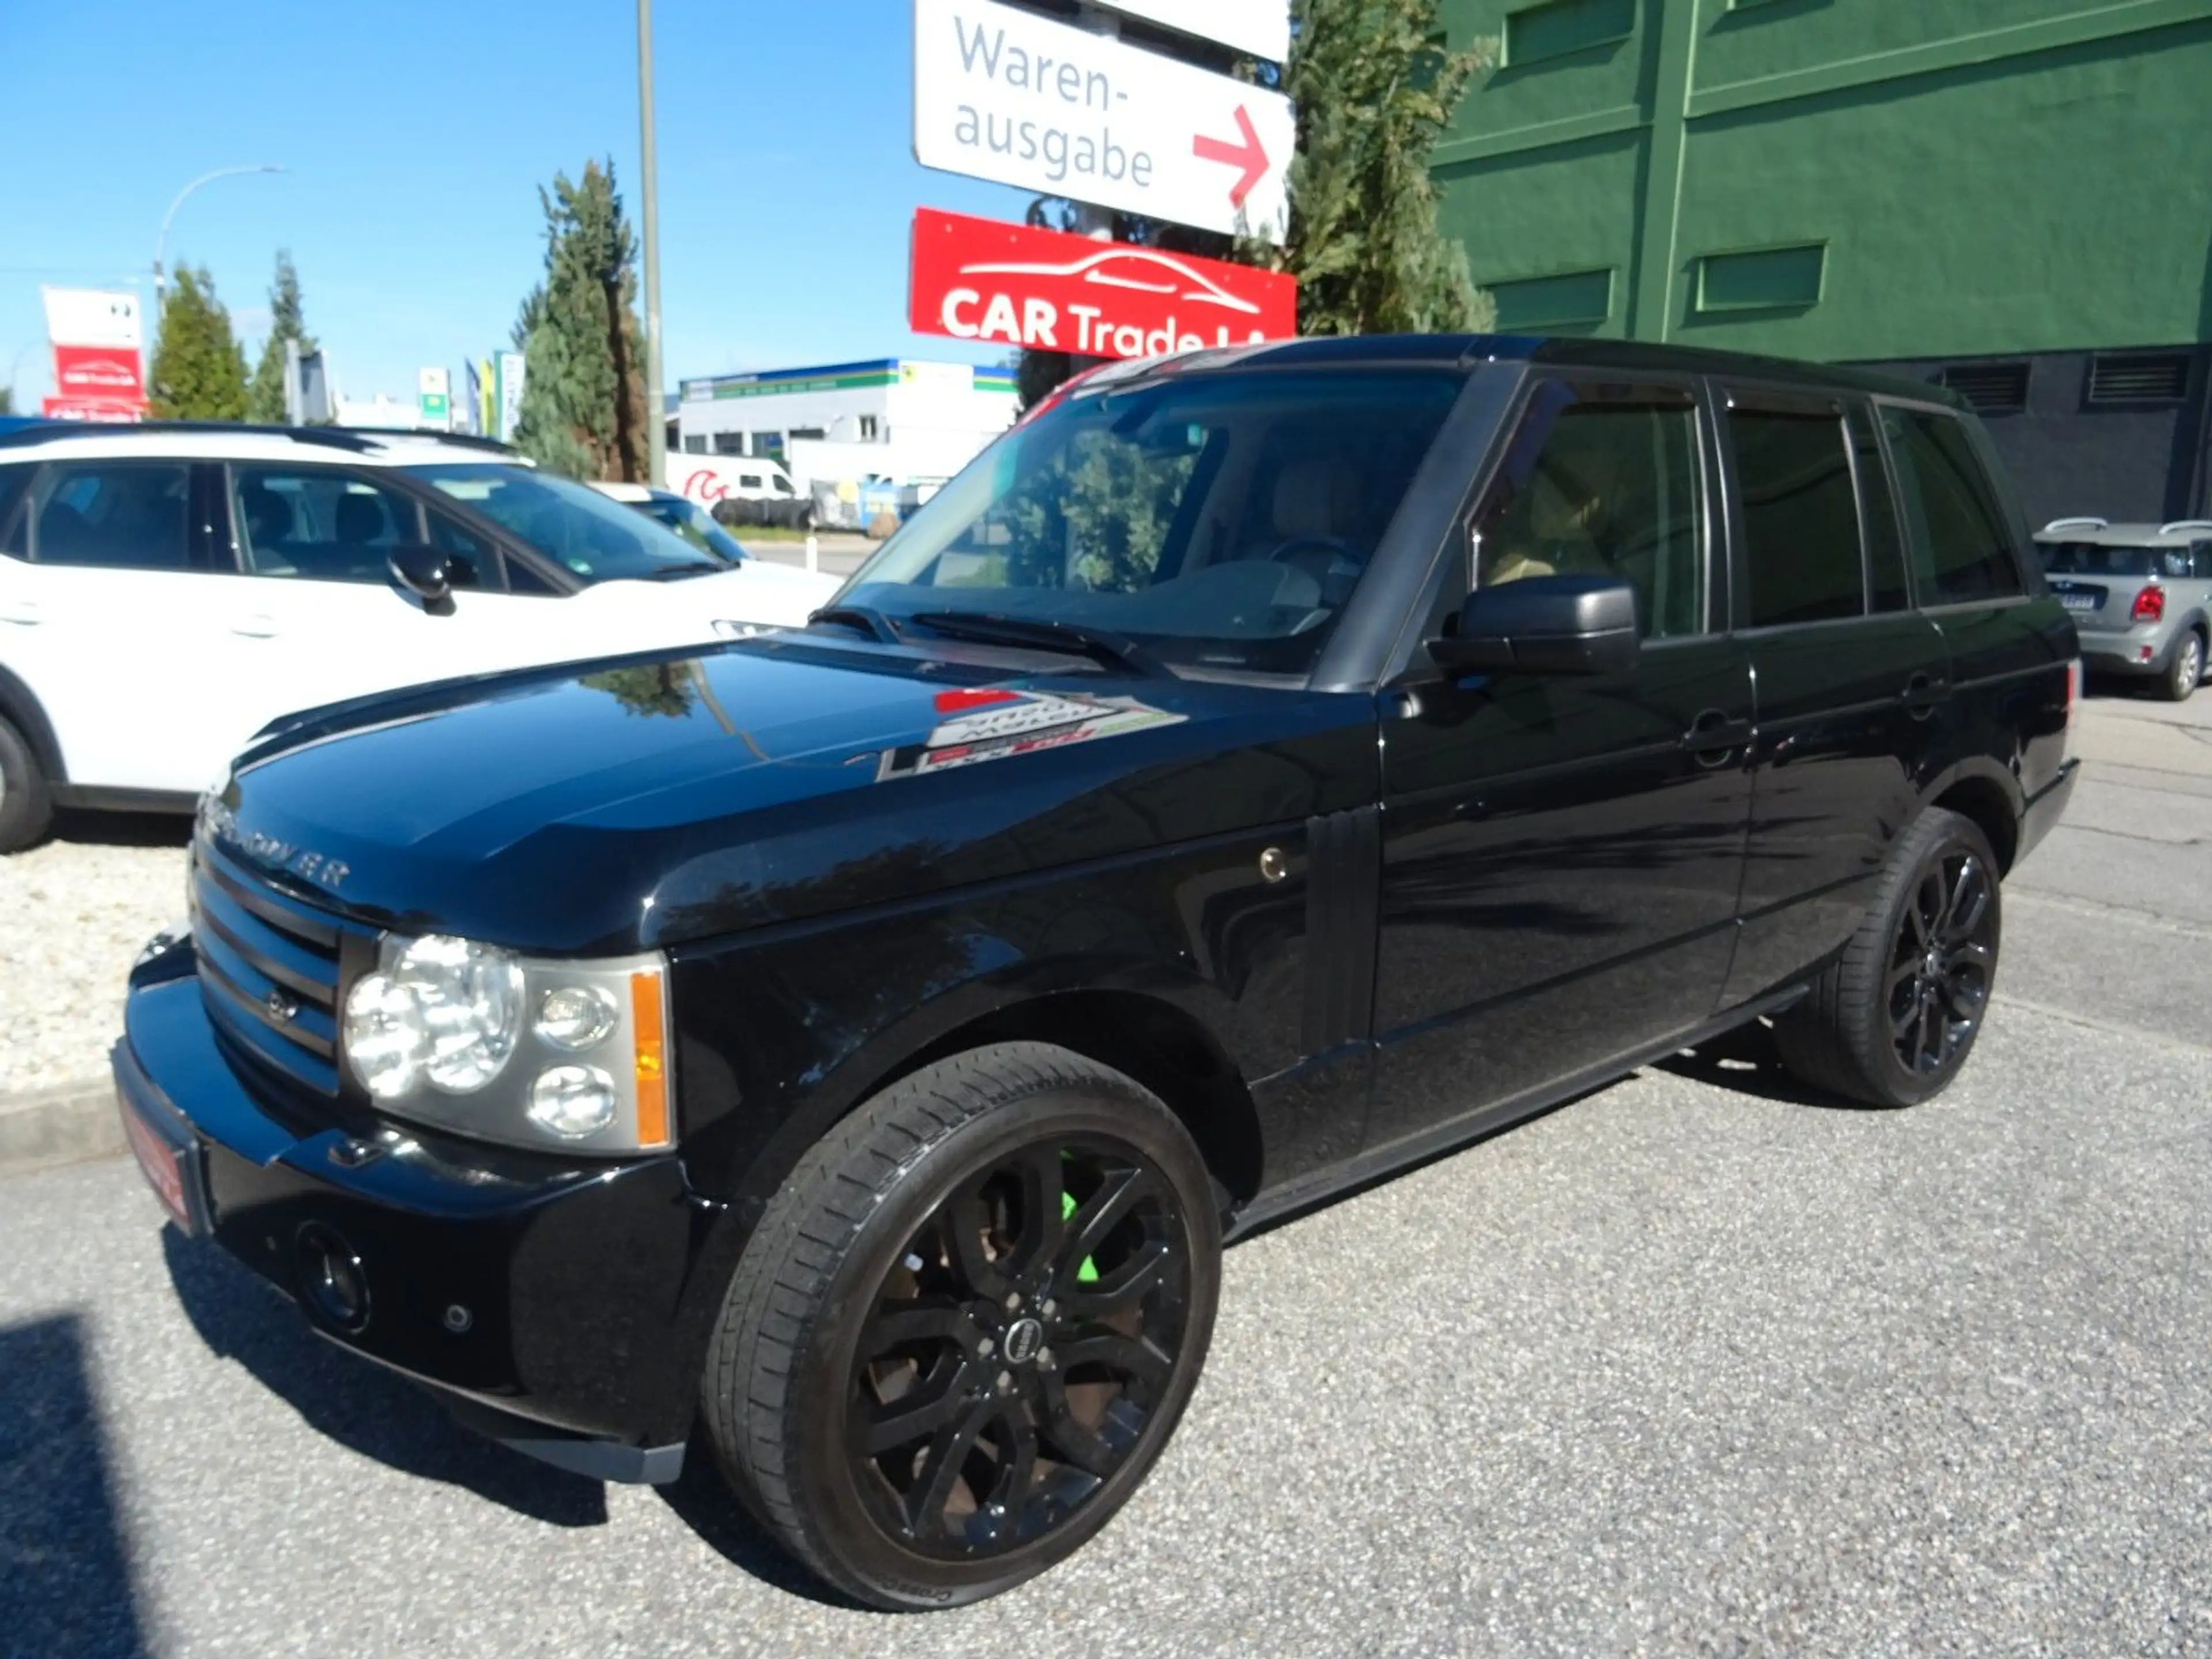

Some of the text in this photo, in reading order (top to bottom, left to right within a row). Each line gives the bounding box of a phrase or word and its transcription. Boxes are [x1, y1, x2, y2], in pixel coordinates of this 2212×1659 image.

[954, 15, 1128, 112] Waren-
[954, 104, 1153, 187] ausgabe
[941, 289, 1058, 347] CAR
[1068, 305, 1203, 358] Trade
